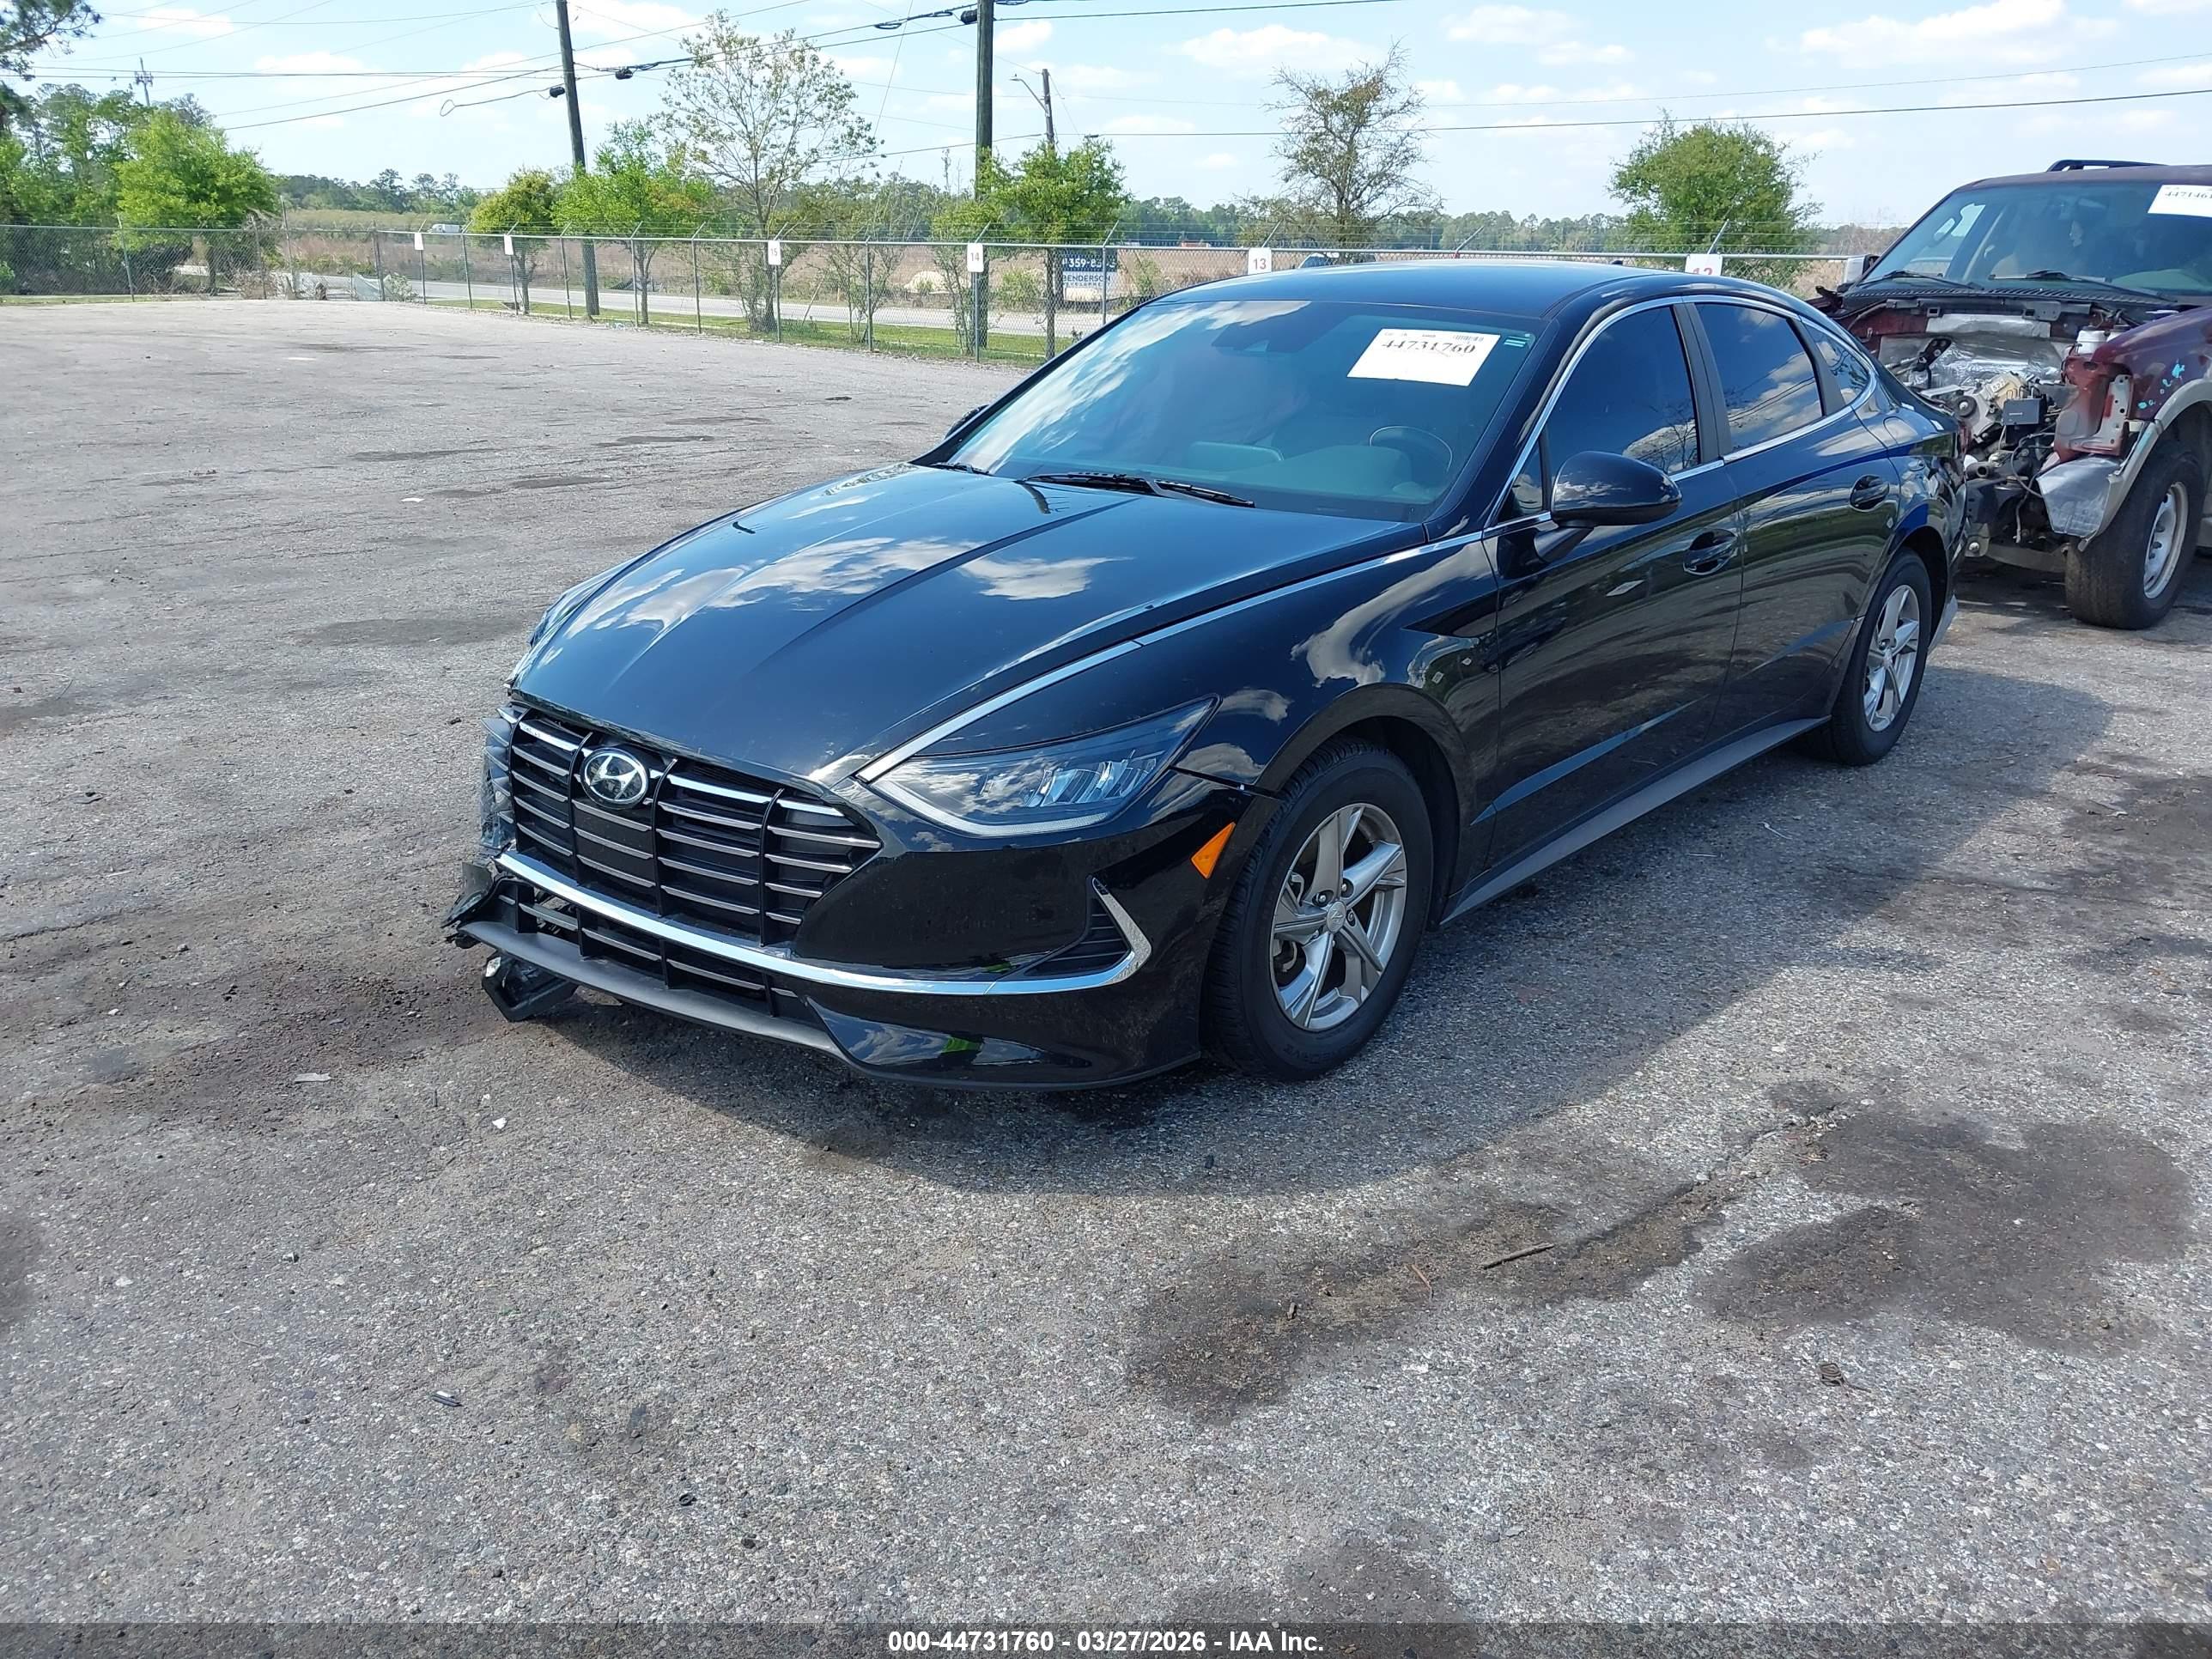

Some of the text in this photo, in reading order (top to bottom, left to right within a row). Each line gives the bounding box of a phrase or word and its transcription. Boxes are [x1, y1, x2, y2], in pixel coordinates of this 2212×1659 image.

[770, 247, 778, 257] 15
[970, 252, 980, 262] 14
[1253, 258, 1267, 270] 13
[1382, 339, 1476, 354] 44731760
